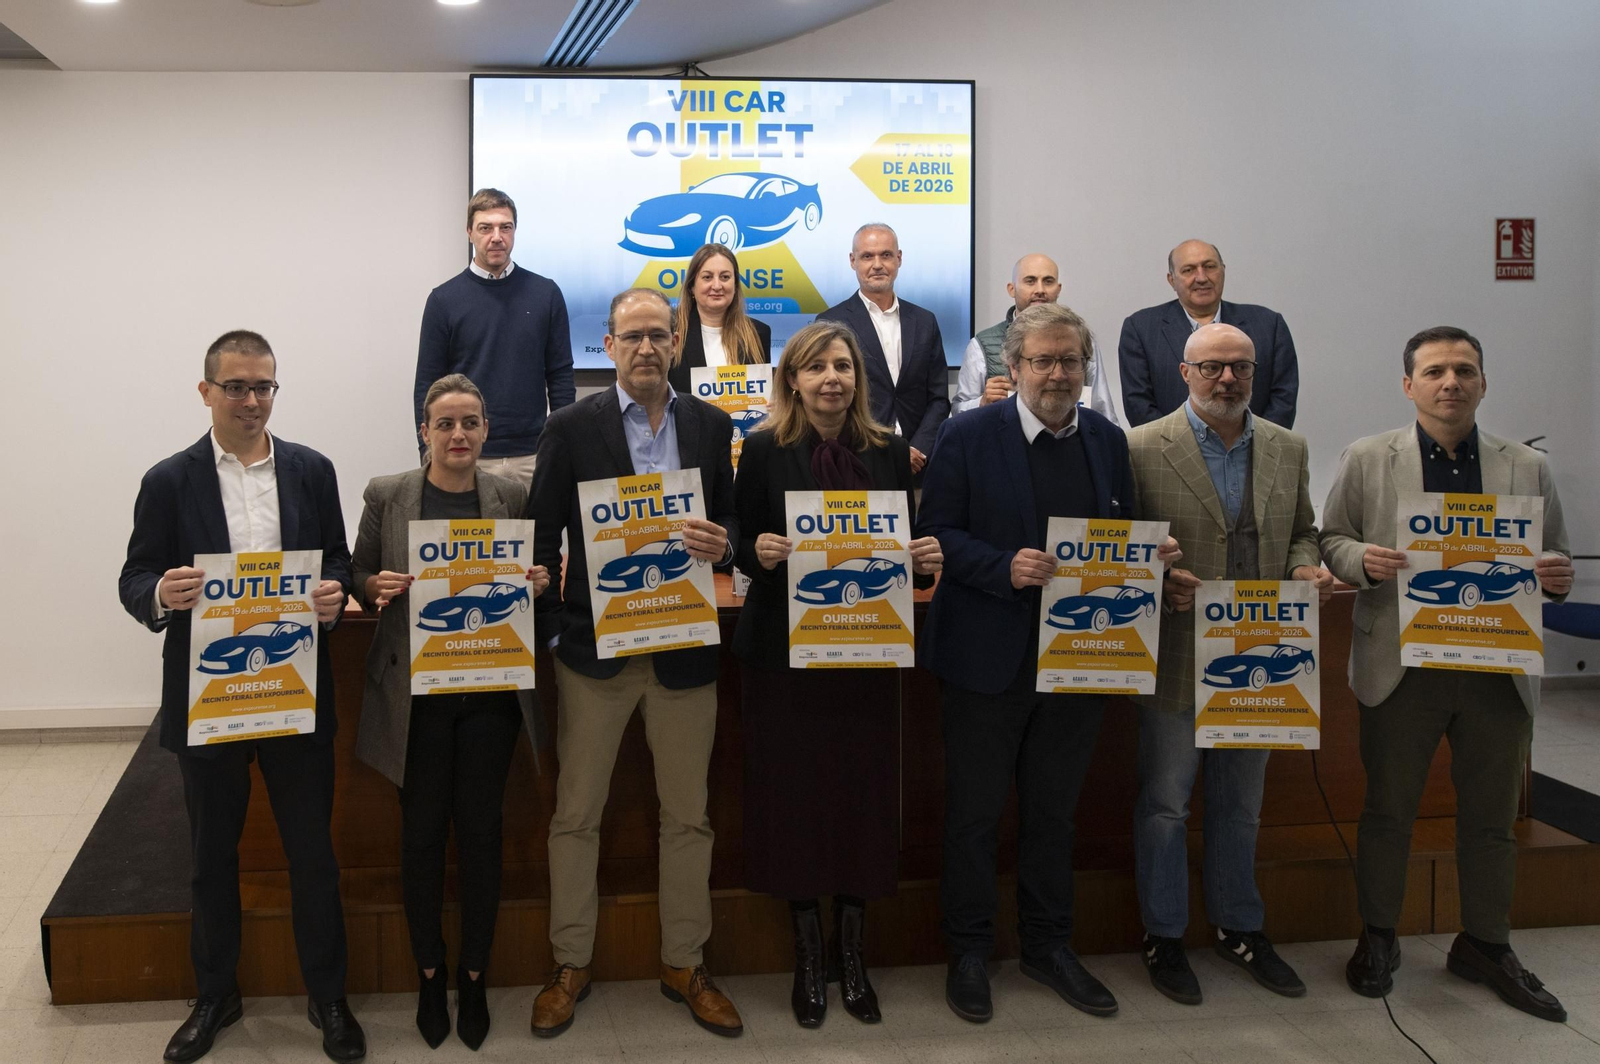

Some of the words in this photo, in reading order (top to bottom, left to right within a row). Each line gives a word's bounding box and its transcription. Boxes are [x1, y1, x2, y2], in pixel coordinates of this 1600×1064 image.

[668, 90, 715, 112] VIII
[724, 90, 785, 112] CAR
[627, 122, 813, 158] OUTLET
[883, 162, 903, 174] DE
[908, 162, 954, 175] ABRIL
[890, 179, 909, 192] DE
[914, 179, 953, 192] 2026
[1497, 266, 1533, 276] EXTINTOR
[698, 380, 766, 396] OUTLET
[622, 486, 637, 495] VIII
[640, 483, 660, 492] CAR
[591, 493, 694, 523] OUTLET
[1469, 504, 1494, 512] CAR
[796, 514, 898, 534] OUTLET
[1409, 515, 1532, 538] OUTLET
[601, 531, 611, 539] 17
[620, 528, 630, 536] 19
[638, 524, 662, 534] ABRIL
[419, 540, 524, 562] OUTLET
[1056, 541, 1157, 564] OUTLET
[1460, 544, 1489, 552] ABRIL
[1499, 546, 1523, 554] 2026
[239, 563, 256, 571] VIII
[259, 562, 280, 570] CAR
[464, 567, 488, 575] ABRIL
[497, 565, 517, 573] 2026
[1128, 570, 1147, 578] 2026
[204, 574, 311, 600] OUTLET
[626, 594, 682, 610] OURENSE
[212, 608, 221, 616] 17
[250, 605, 274, 614] ABRIL
[283, 602, 304, 612] 2026
[606, 611, 632, 619] RECINTO
[665, 602, 705, 612] EXPOURENSE
[1205, 603, 1309, 622] OUTLET
[823, 614, 878, 623] OURENSE
[1438, 614, 1502, 627] OURENSE
[1482, 627, 1529, 636] EXPOURENSE
[445, 638, 500, 650] OURENSE
[1071, 639, 1125, 650] OURENSE
[1446, 637, 1496, 645] www.expourense.org
[226, 679, 283, 694] OURENSE
[202, 695, 230, 703] RECINTO
[264, 688, 305, 698] EXPOURENSE
[1230, 697, 1286, 707] OURENSE
